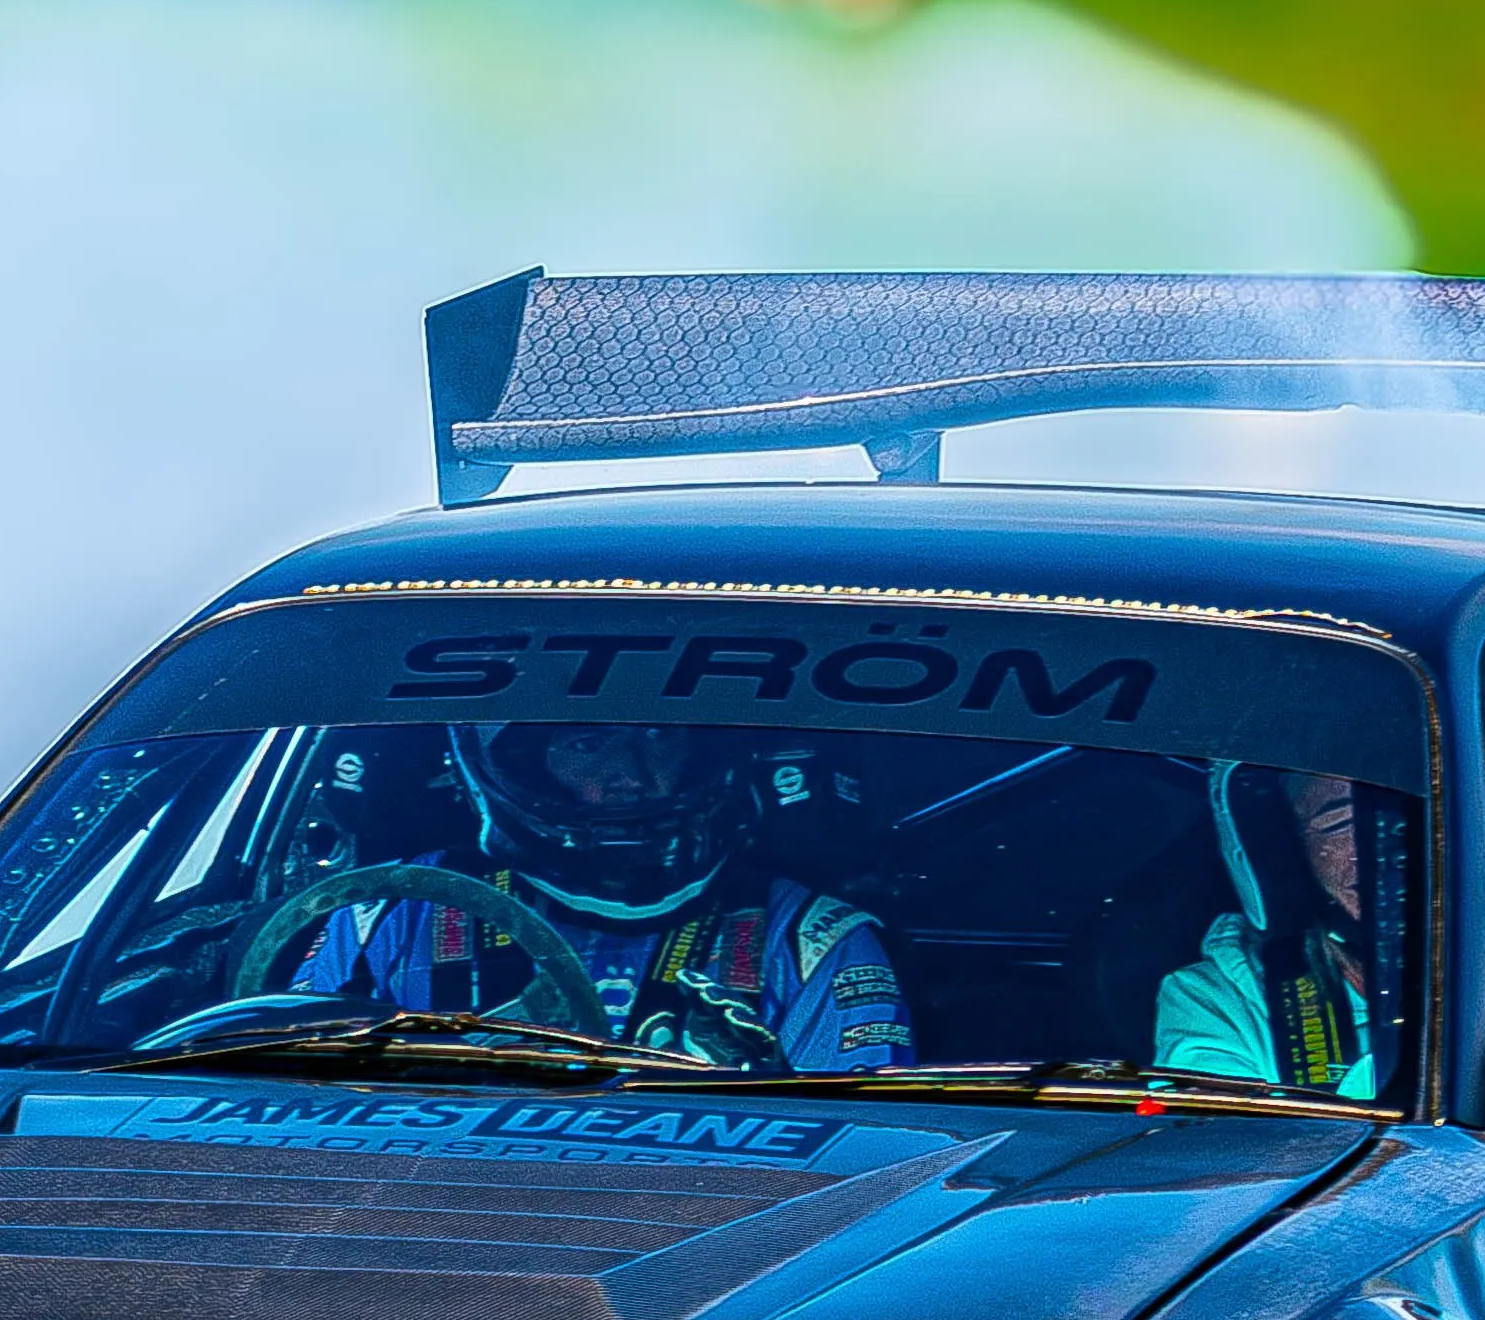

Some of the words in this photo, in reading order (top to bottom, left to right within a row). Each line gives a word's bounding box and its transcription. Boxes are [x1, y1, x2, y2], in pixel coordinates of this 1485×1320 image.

[387, 622, 1159, 725] STRÖM
[151, 1096, 474, 1129] JAMES
[498, 1104, 825, 1153] DEANE
